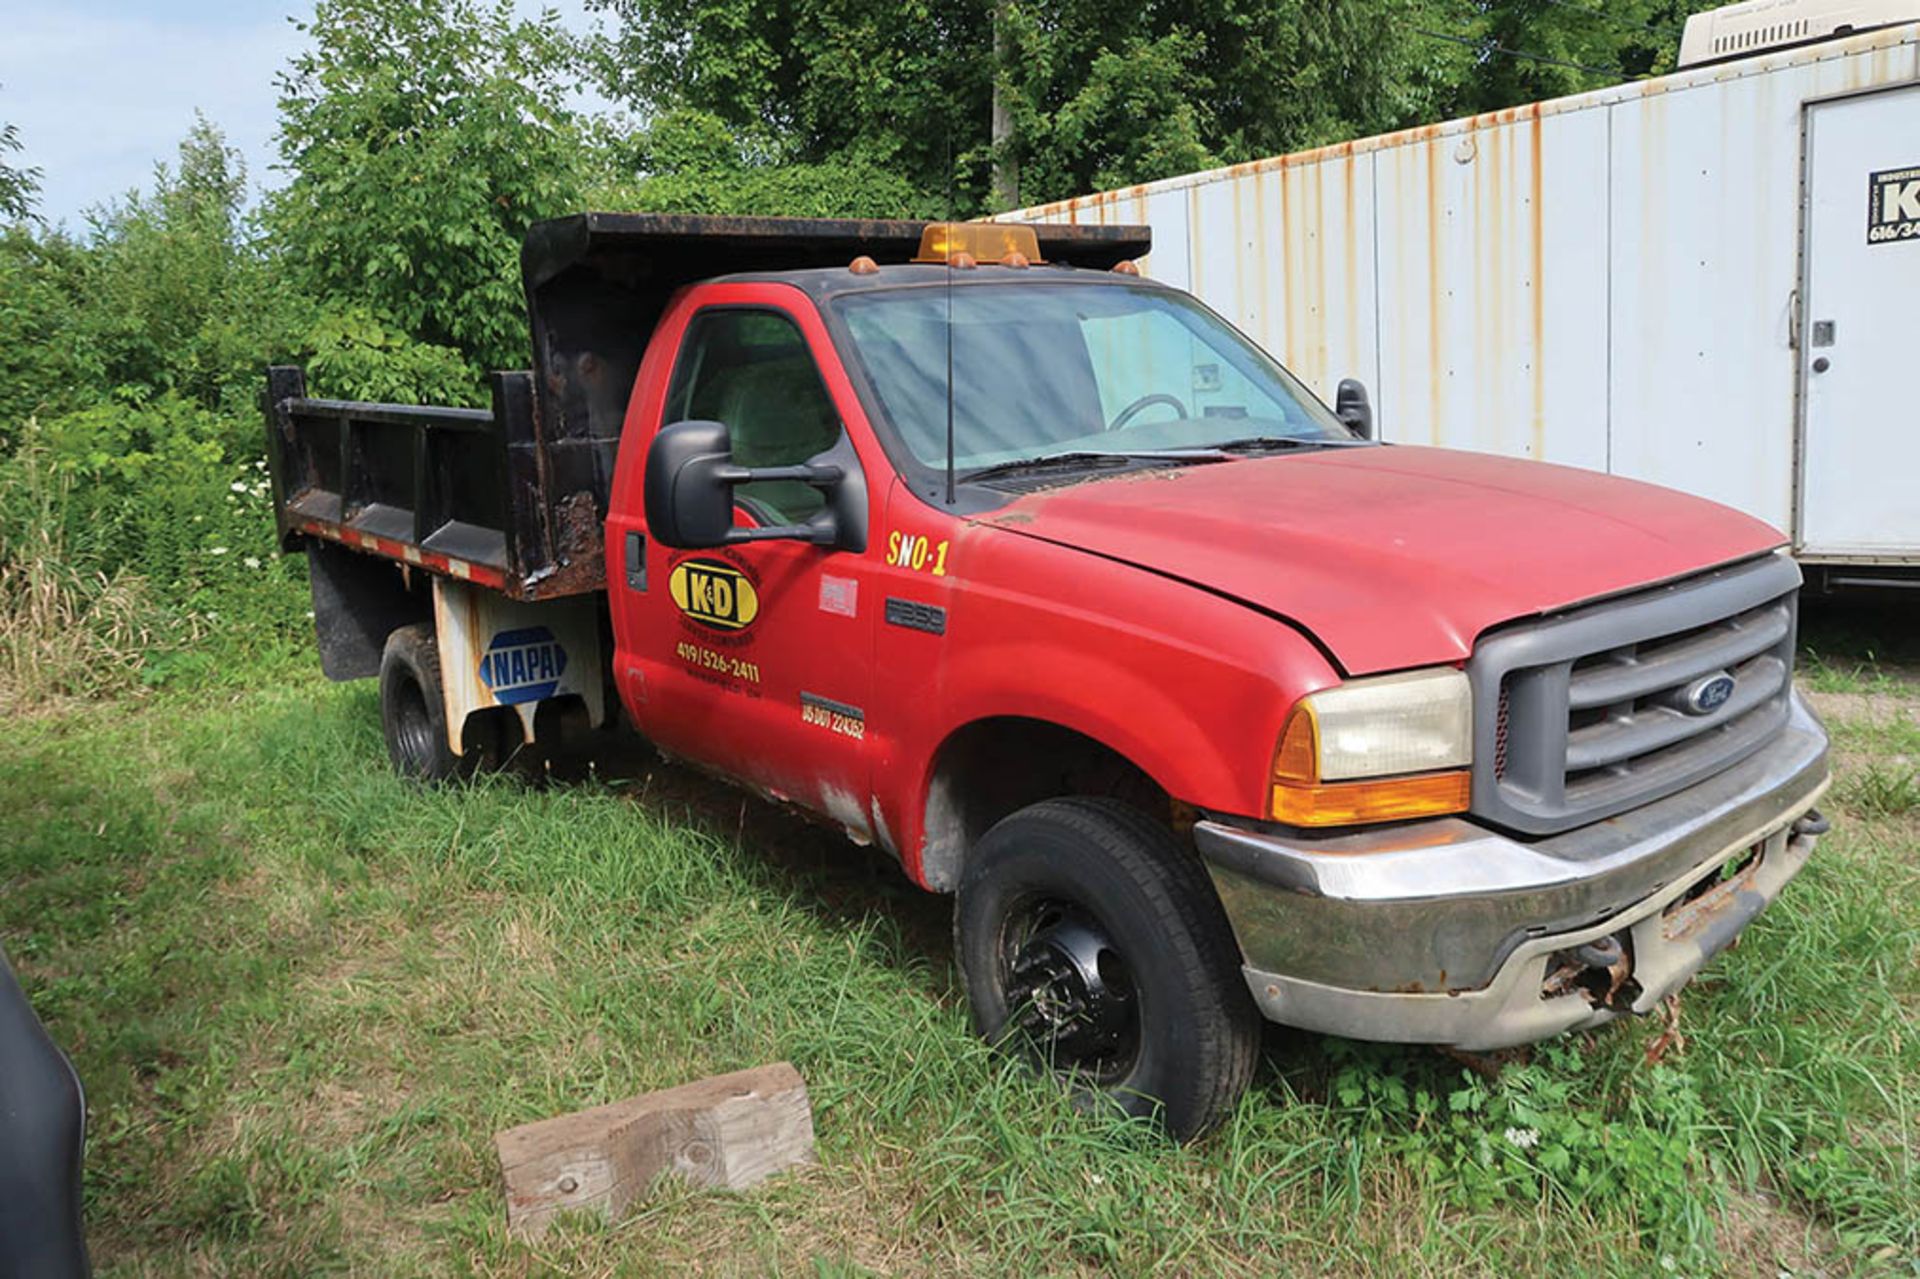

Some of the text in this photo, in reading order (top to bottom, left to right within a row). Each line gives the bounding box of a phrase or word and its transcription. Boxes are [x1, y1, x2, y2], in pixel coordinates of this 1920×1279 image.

[690, 573, 733, 617] K&D
[493, 644, 556, 688] NAPA
[677, 640, 761, 684] 419/526-2411
